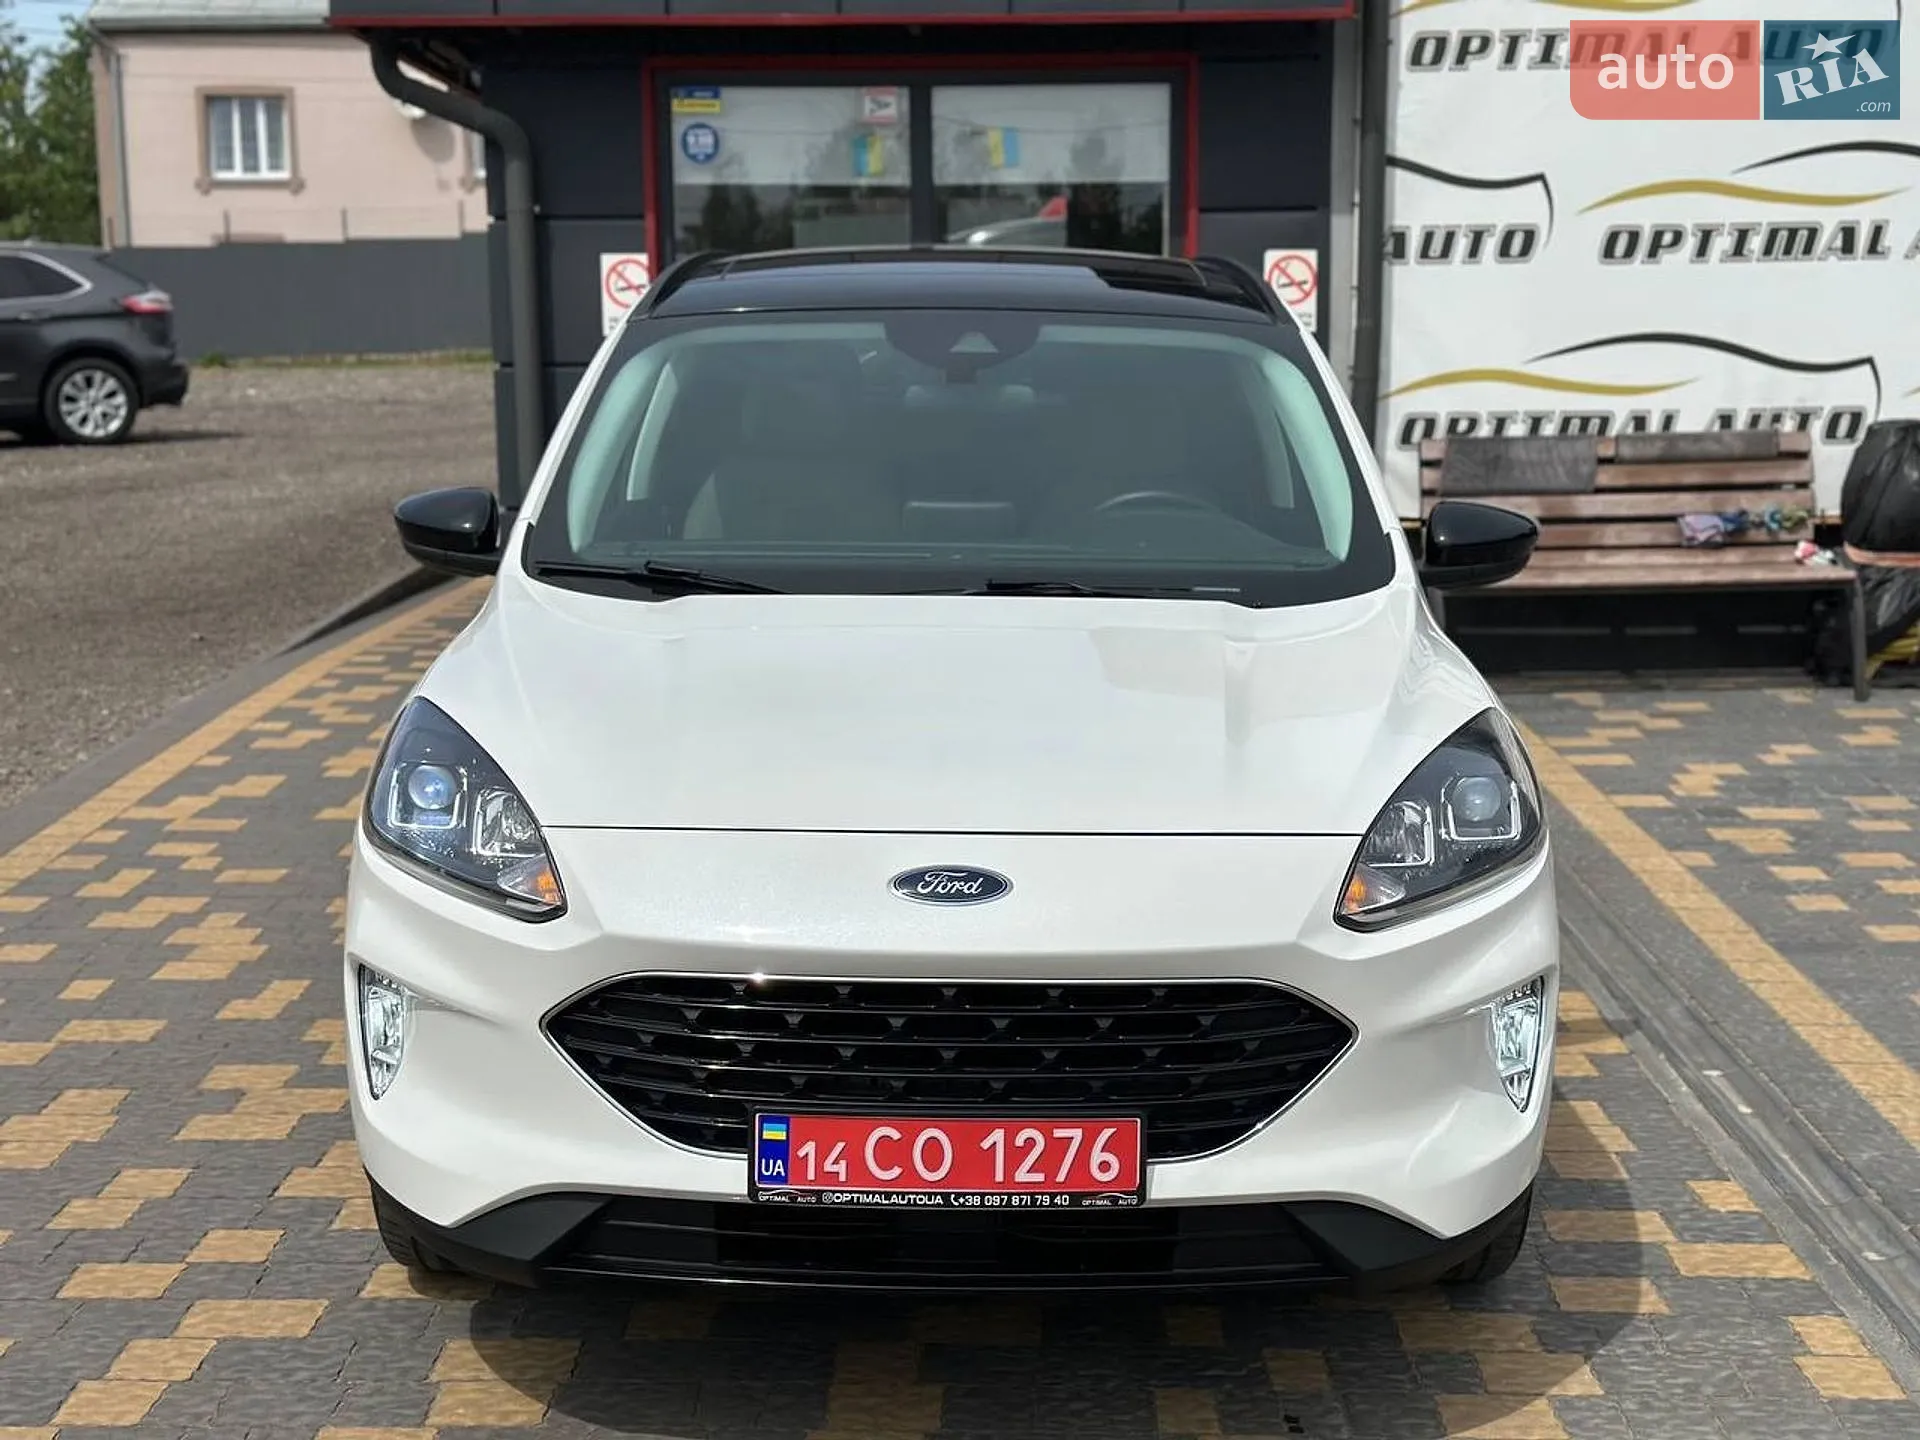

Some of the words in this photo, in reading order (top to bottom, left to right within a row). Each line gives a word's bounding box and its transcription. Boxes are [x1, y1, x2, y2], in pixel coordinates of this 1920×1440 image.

[1598, 219, 1892, 266] OPTIMAL
[917, 871, 984, 894] Ford
[796, 1140, 848, 1182] 14
[864, 1126, 954, 1182] CO
[979, 1126, 1121, 1184] 1276
[761, 1158, 786, 1177] UA
[758, 1194, 790, 1203] OPTIMAL
[797, 1196, 817, 1204] AUTO
[958, 1194, 981, 1206] +38
[984, 1194, 1008, 1206] 097
[1011, 1194, 1031, 1206] 871
[1035, 1194, 1050, 1206] 79
[1053, 1194, 1070, 1206] 40
[1081, 1198, 1112, 1206] OPTIMAL
[1118, 1197, 1138, 1206] AUTO
